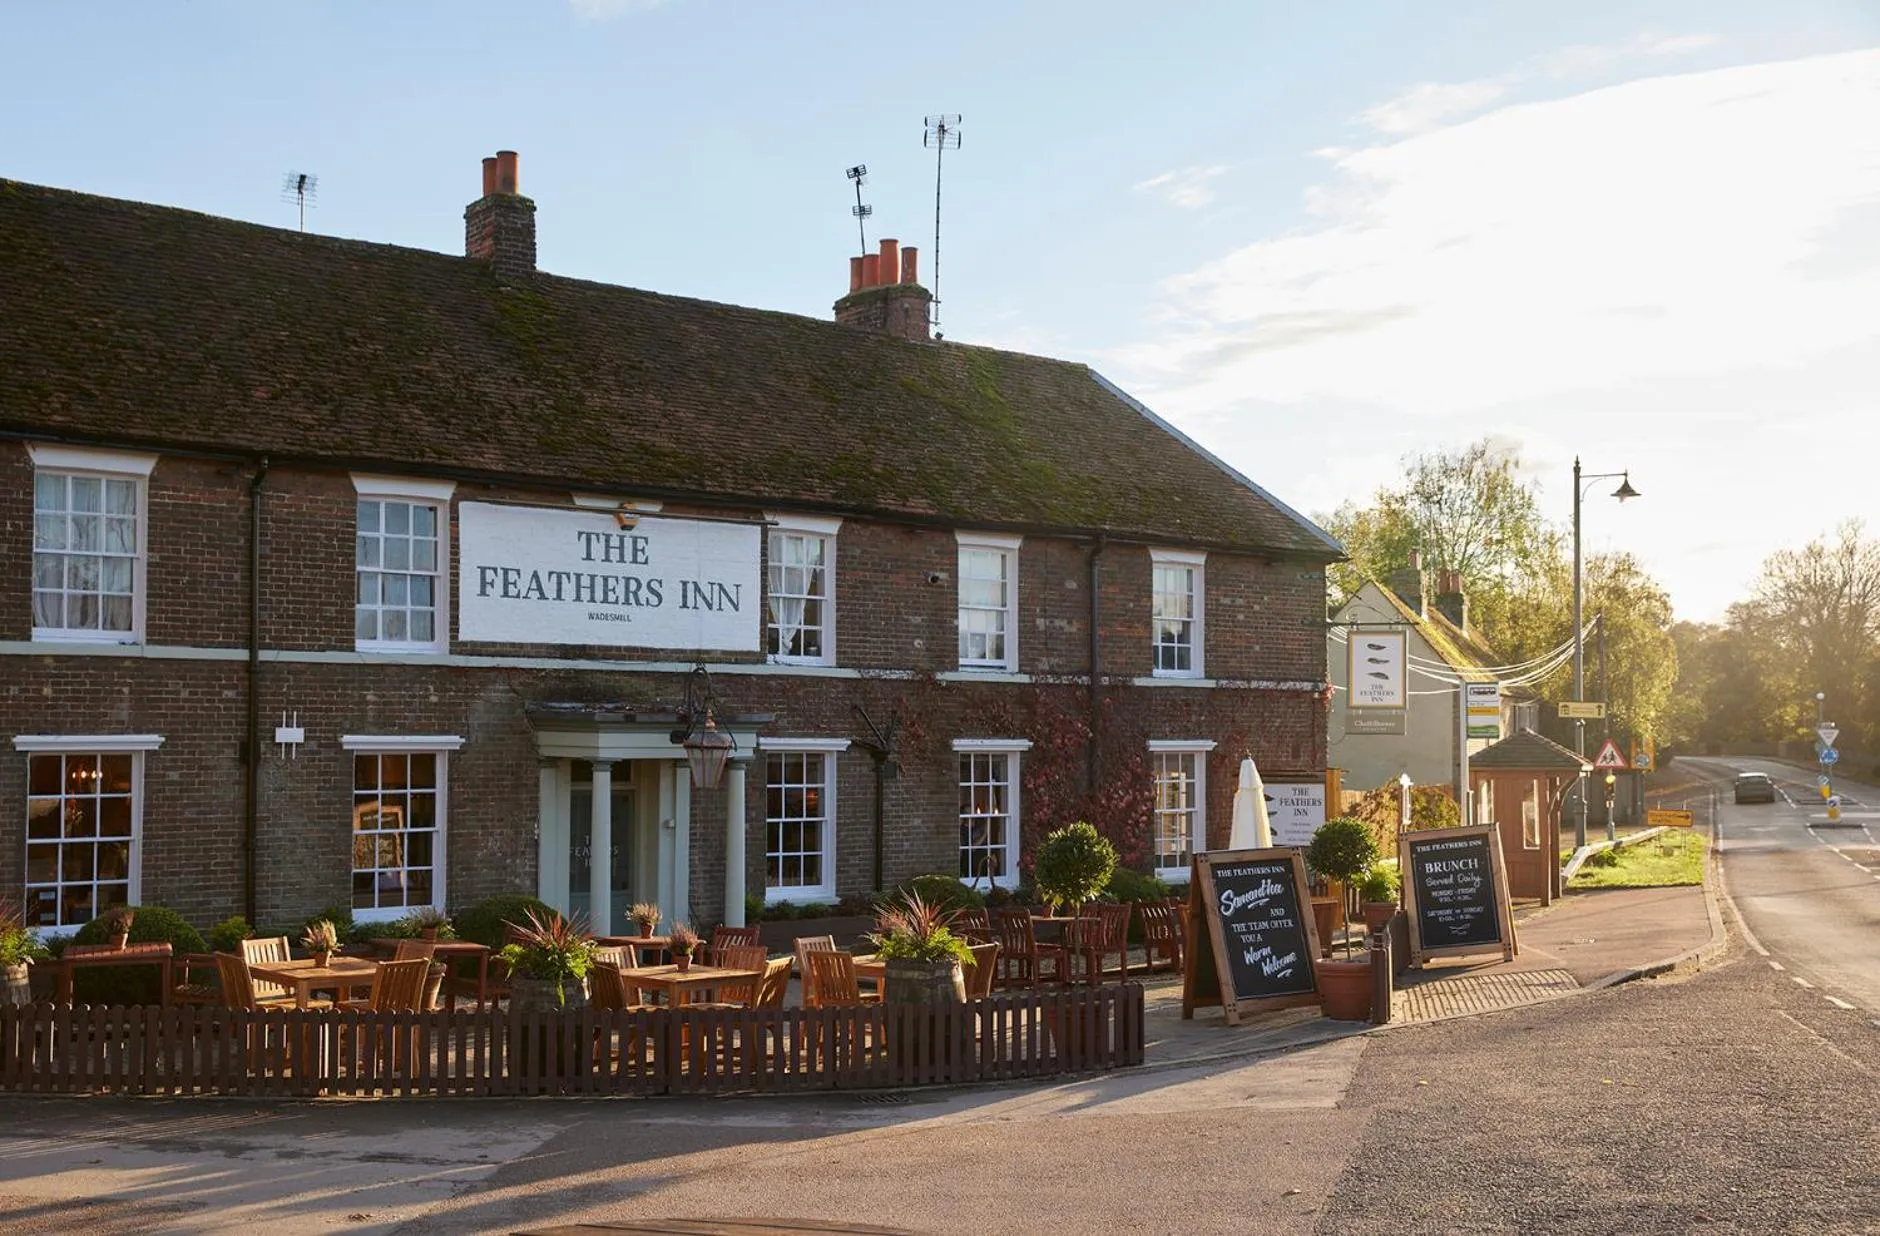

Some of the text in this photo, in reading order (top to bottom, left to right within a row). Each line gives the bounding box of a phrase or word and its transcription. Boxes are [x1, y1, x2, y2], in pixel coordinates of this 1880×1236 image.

[577, 531, 649, 565] THE
[477, 566, 742, 612] FEATHERS INN
[587, 612, 632, 622] WADESMILL
[1292, 787, 1309, 796] THE
[1280, 797, 1322, 807] FEATHERS
[1293, 808, 1308, 817] INN
[1416, 839, 1482, 853] THE FEATHERS INN
[1217, 866, 1286, 877] THE FEATHERS INN
[1425, 858, 1479, 873] BRUNCH
[1425, 872, 1483, 888] Served Daily
[1220, 878, 1285, 917] Samantha
[1270, 908, 1285, 917] AND
[1232, 918, 1294, 933] THE TEAM OFFER
[1240, 933, 1263, 944] YOU A
[1243, 946, 1272, 965] Warm
[1261, 952, 1297, 977] Welcome
